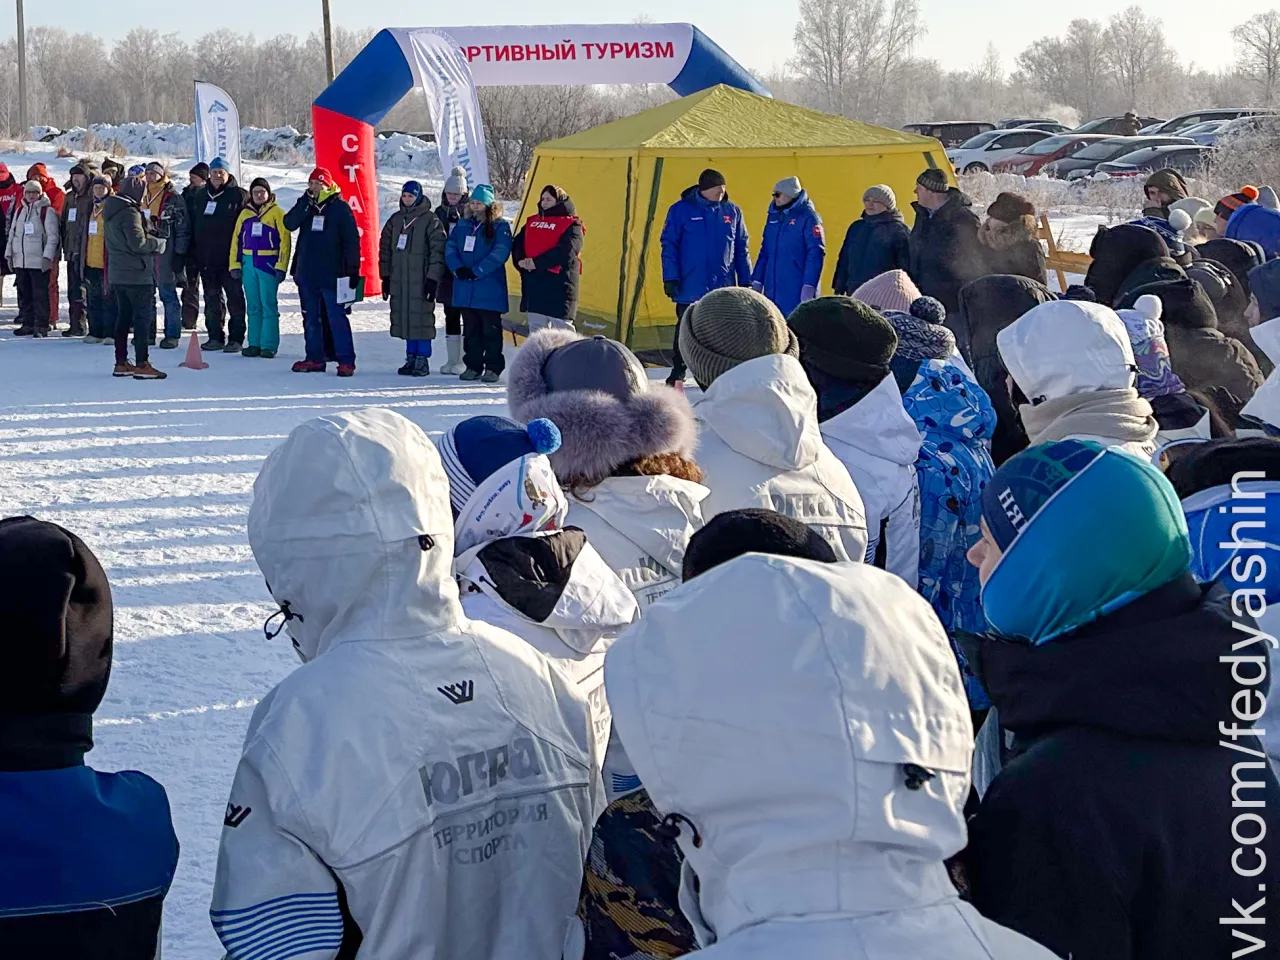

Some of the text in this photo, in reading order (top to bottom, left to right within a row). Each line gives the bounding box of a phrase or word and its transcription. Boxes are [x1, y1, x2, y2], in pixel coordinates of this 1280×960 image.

[581, 41, 675, 60] ТУРИЗМ
[340, 133, 366, 262] СТА
[433, 802, 549, 850] ТЕРРИТОРИЯ
[454, 829, 530, 865] СПОРТА
